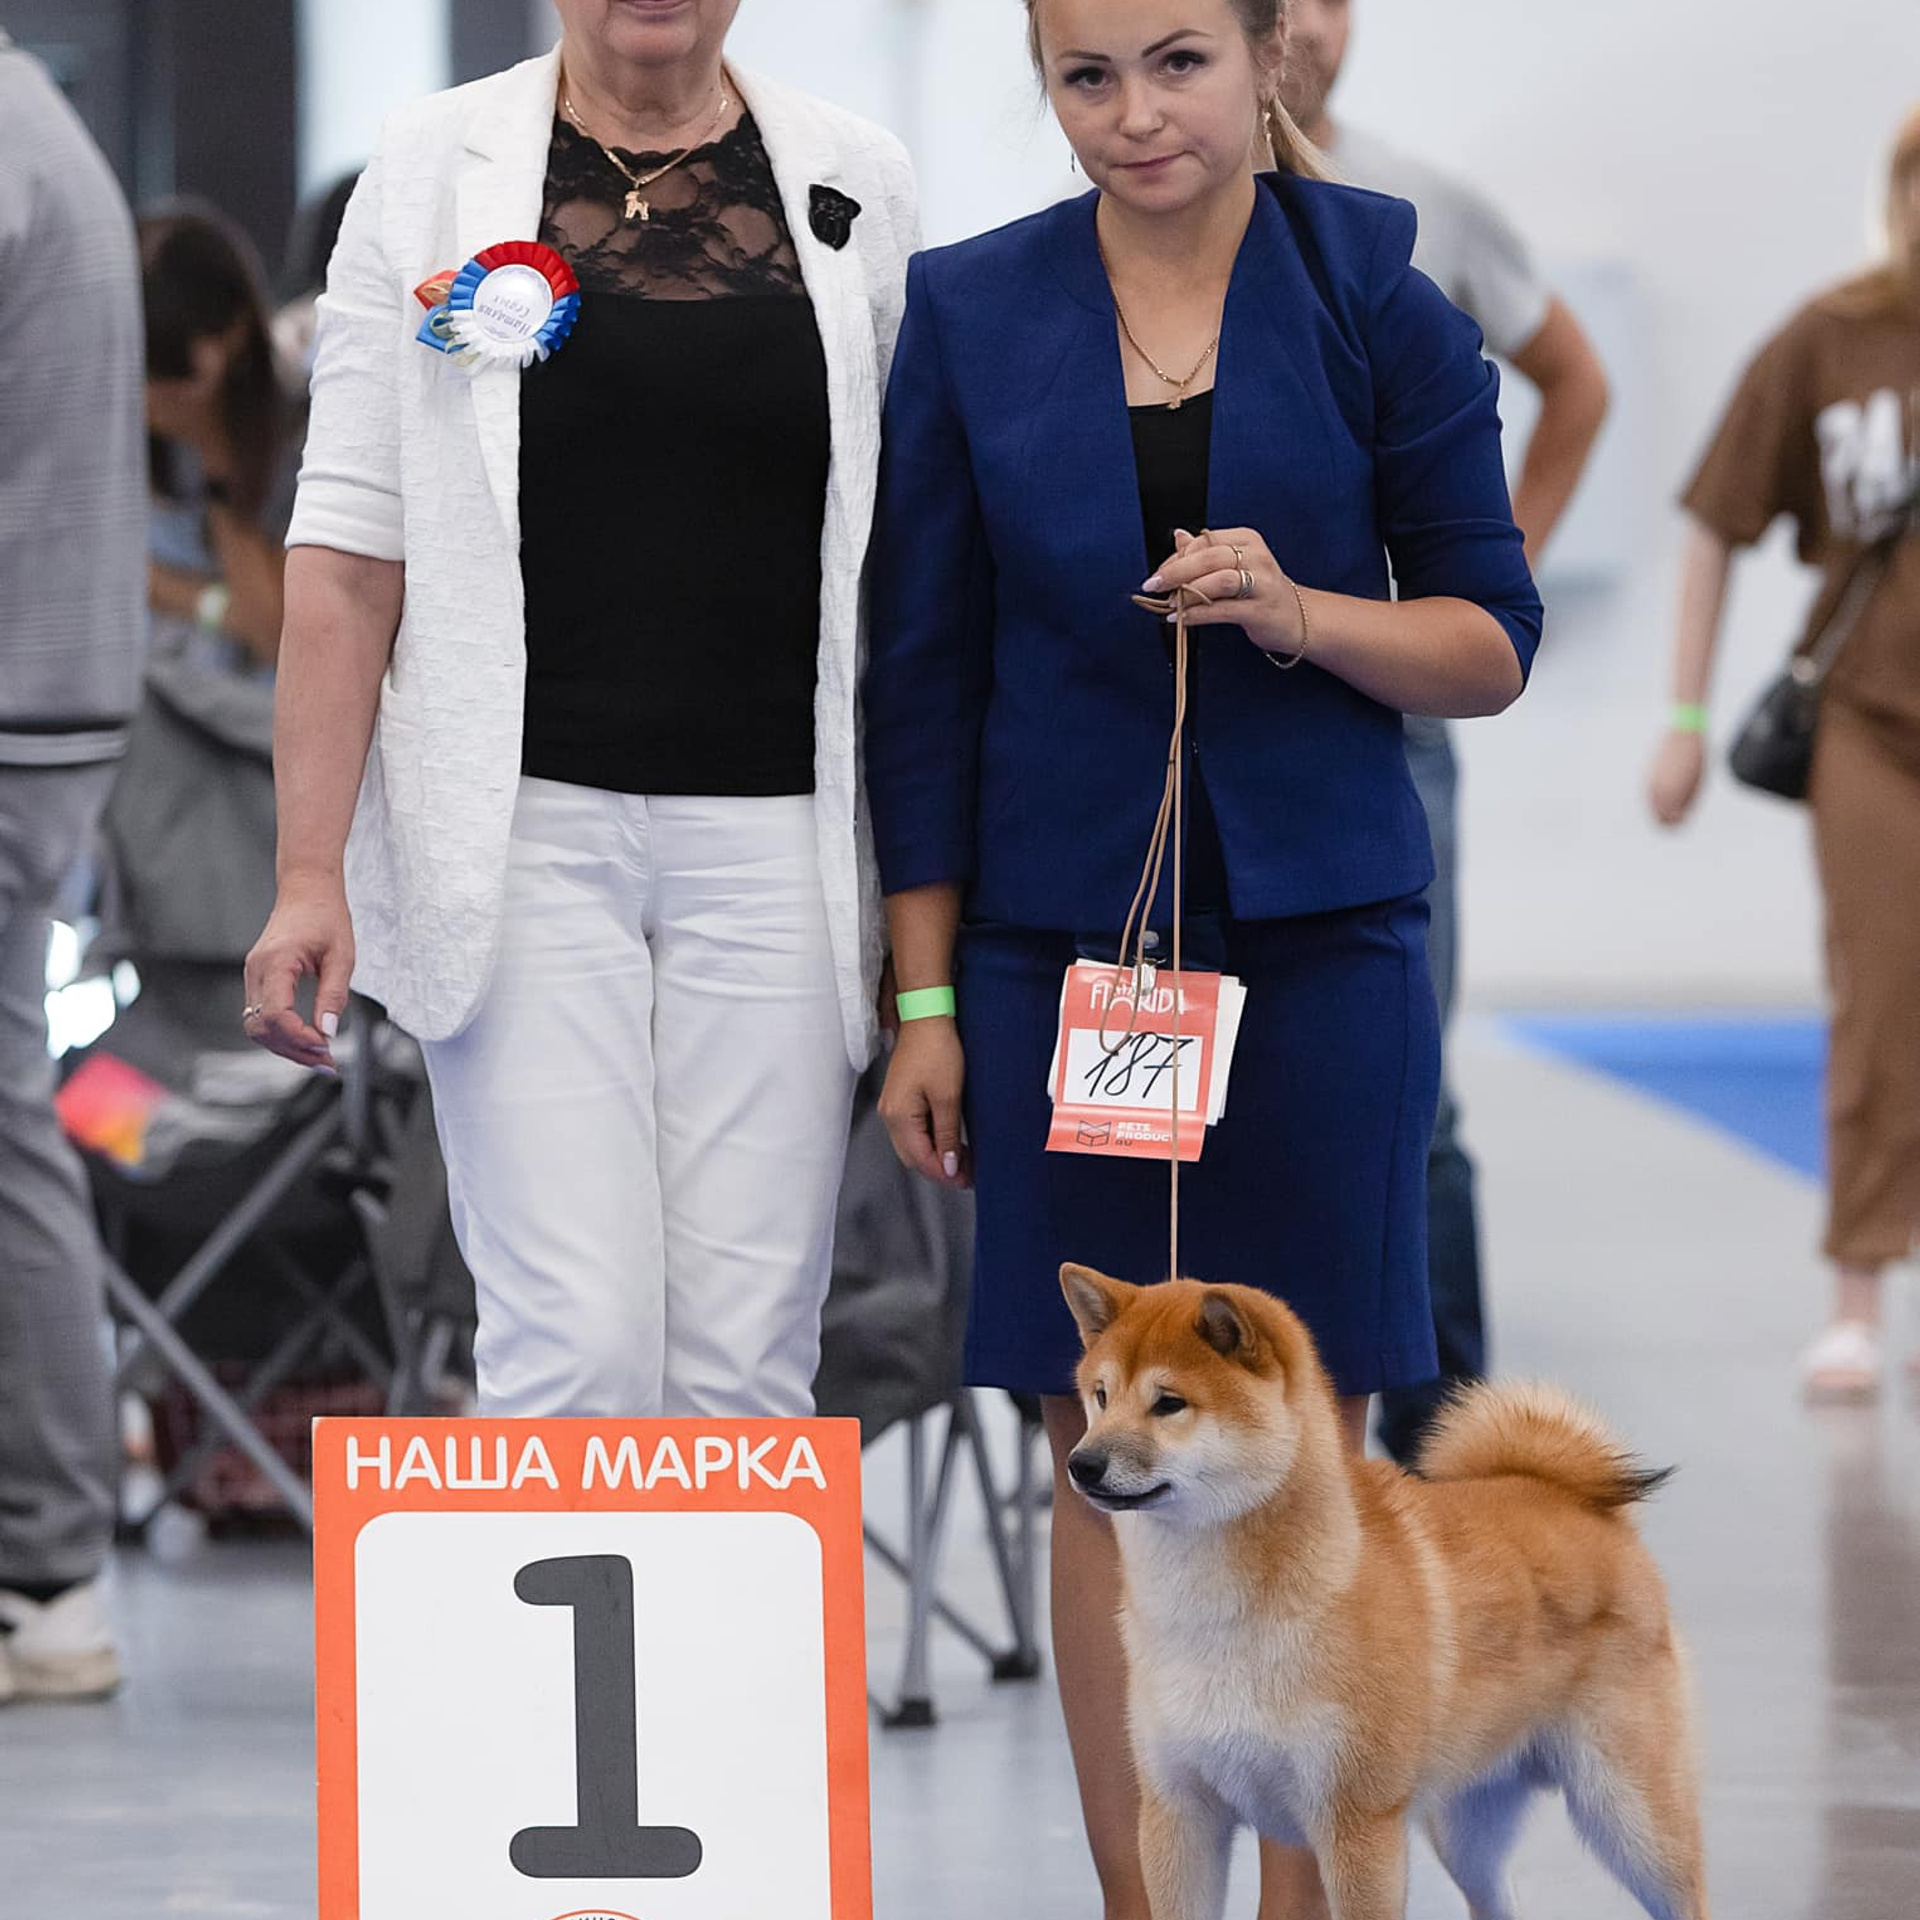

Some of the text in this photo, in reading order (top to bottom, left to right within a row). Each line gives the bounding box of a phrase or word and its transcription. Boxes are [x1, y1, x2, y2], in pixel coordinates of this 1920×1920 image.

[1084, 1031, 1194, 1099] 187
[1116, 1131, 1176, 1142] PRODUC
[346, 1435, 827, 1490] НАША МАРКА
[508, 1554, 703, 1878] 1
